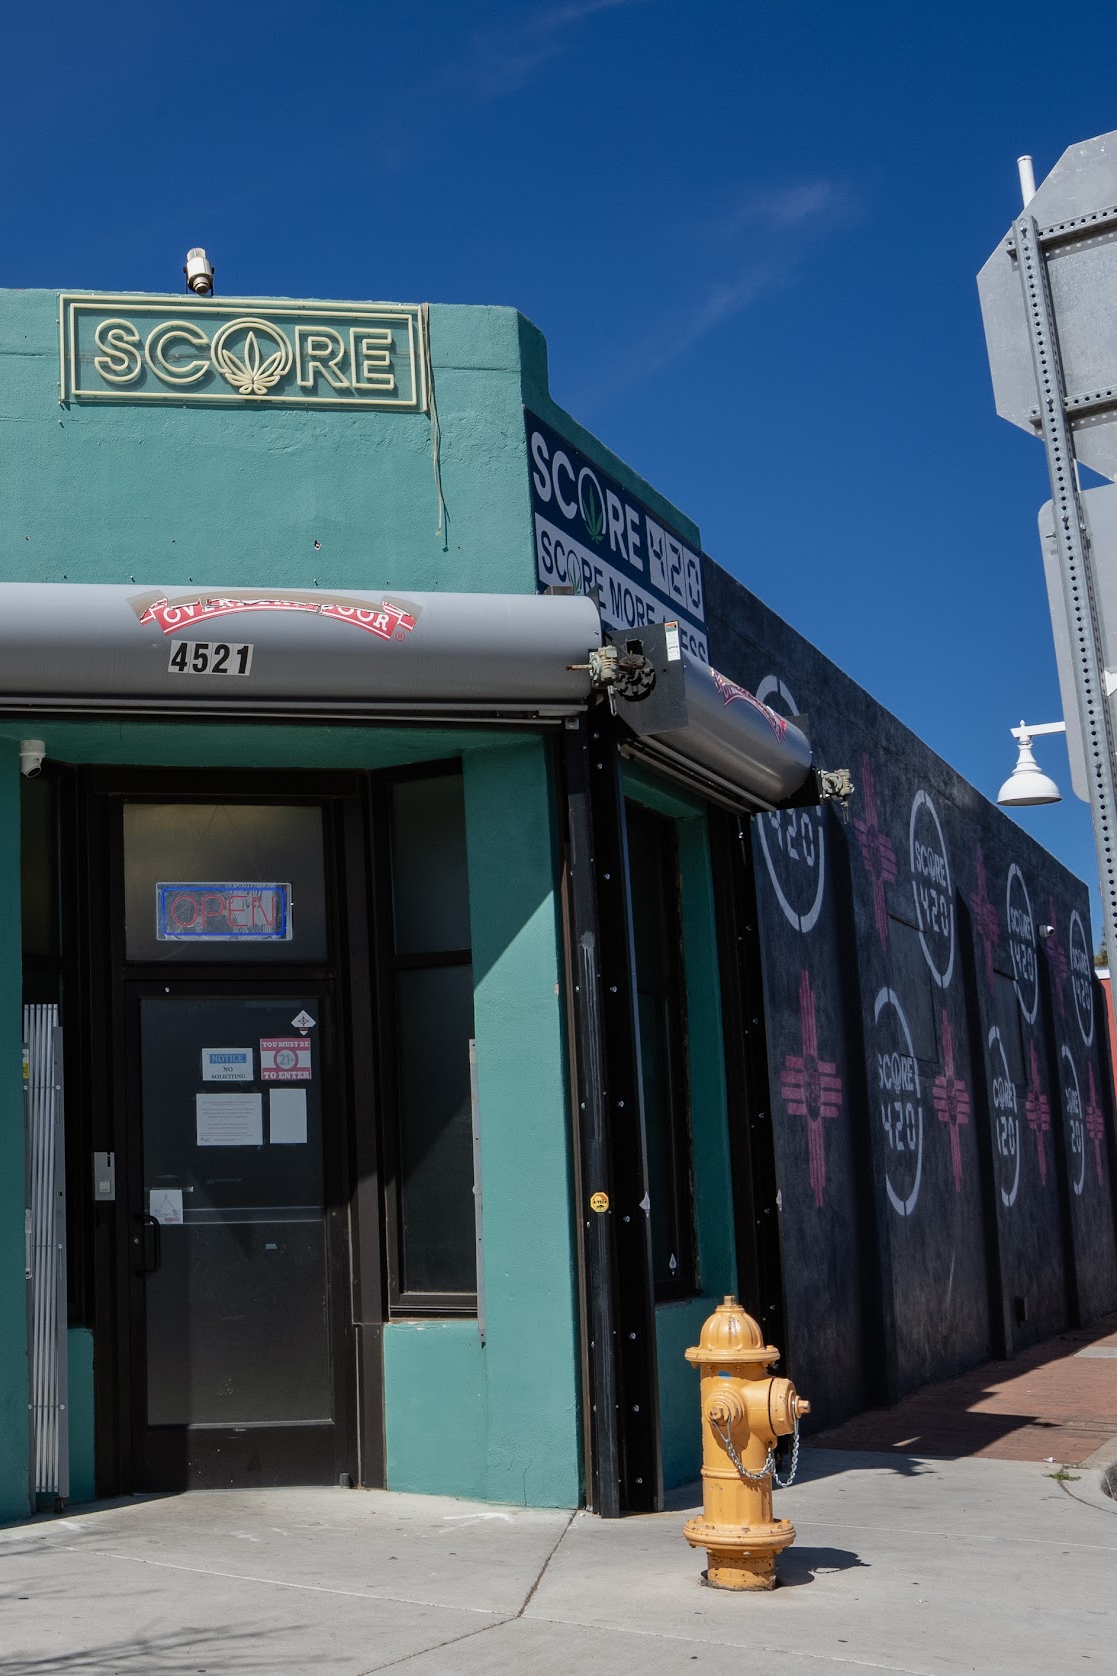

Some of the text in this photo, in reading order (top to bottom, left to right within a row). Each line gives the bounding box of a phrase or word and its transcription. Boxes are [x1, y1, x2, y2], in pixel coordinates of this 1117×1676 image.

[93, 317, 396, 395] SCORE
[531, 431, 701, 609] SCORE 420
[609, 576, 656, 627] MORE
[170, 641, 250, 675] 4521
[915, 840, 946, 887] SCORE
[170, 894, 276, 929] OPEN
[919, 883, 948, 936] 420
[211, 1054, 244, 1063] NOTICE
[263, 1071, 310, 1080] TO ENTER
[279, 1053, 295, 1066] 21+
[881, 1102, 916, 1151] 420
